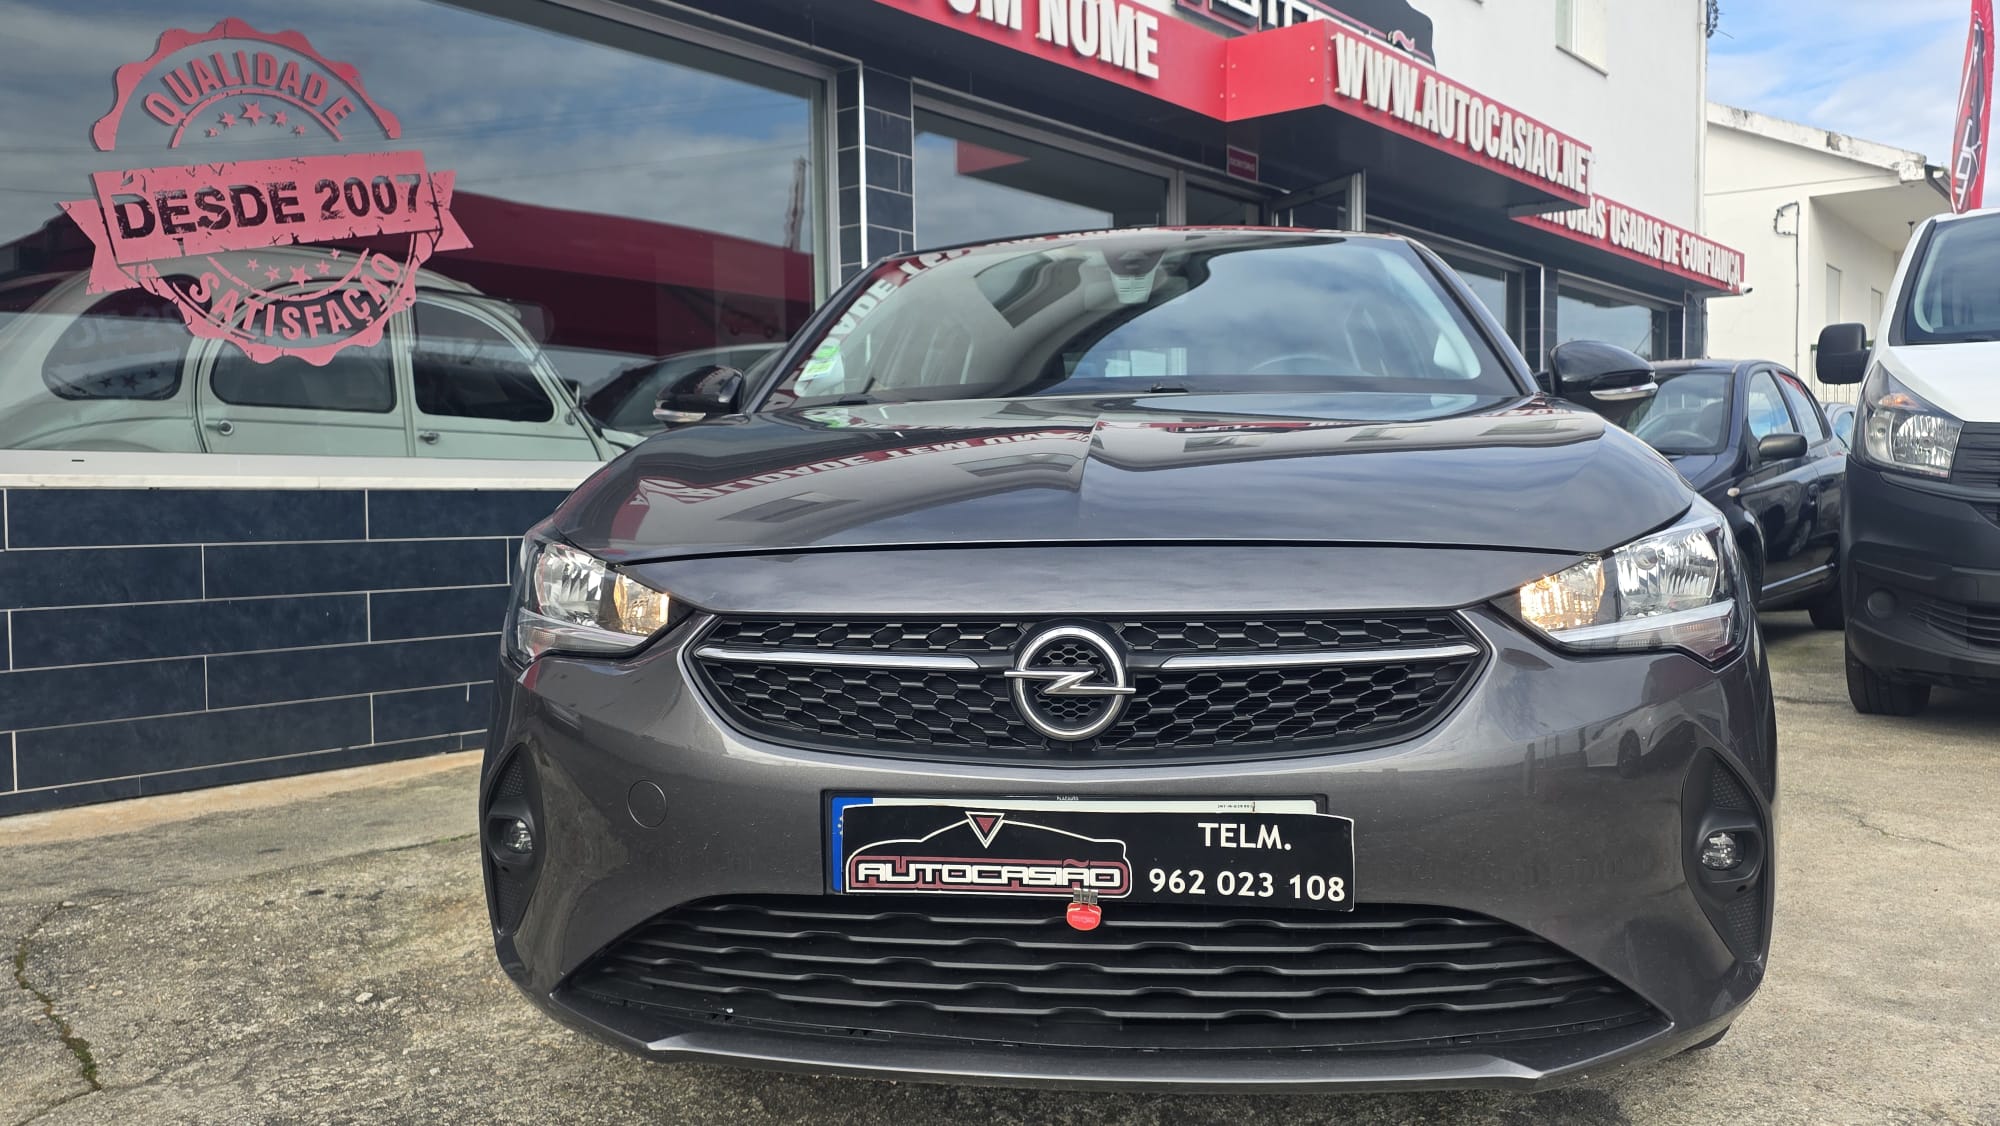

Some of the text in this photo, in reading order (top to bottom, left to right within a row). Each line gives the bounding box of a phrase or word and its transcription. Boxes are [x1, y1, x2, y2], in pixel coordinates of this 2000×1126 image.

[1039, 0, 1160, 80] NOME
[143, 50, 356, 127] QUALIDADE
[1334, 32, 1596, 196] WWW.AUTOCASIAO.NET
[111, 173, 422, 240] DESDE 2007
[1609, 205, 1663, 260] USADAS
[1663, 227, 1680, 265] DE
[1681, 234, 1741, 288] CONFIANÇA
[1197, 822, 1292, 850] TELM.
[858, 859, 1121, 887] AUTOCASIÃO
[1149, 868, 1345, 902] 962 023 108
